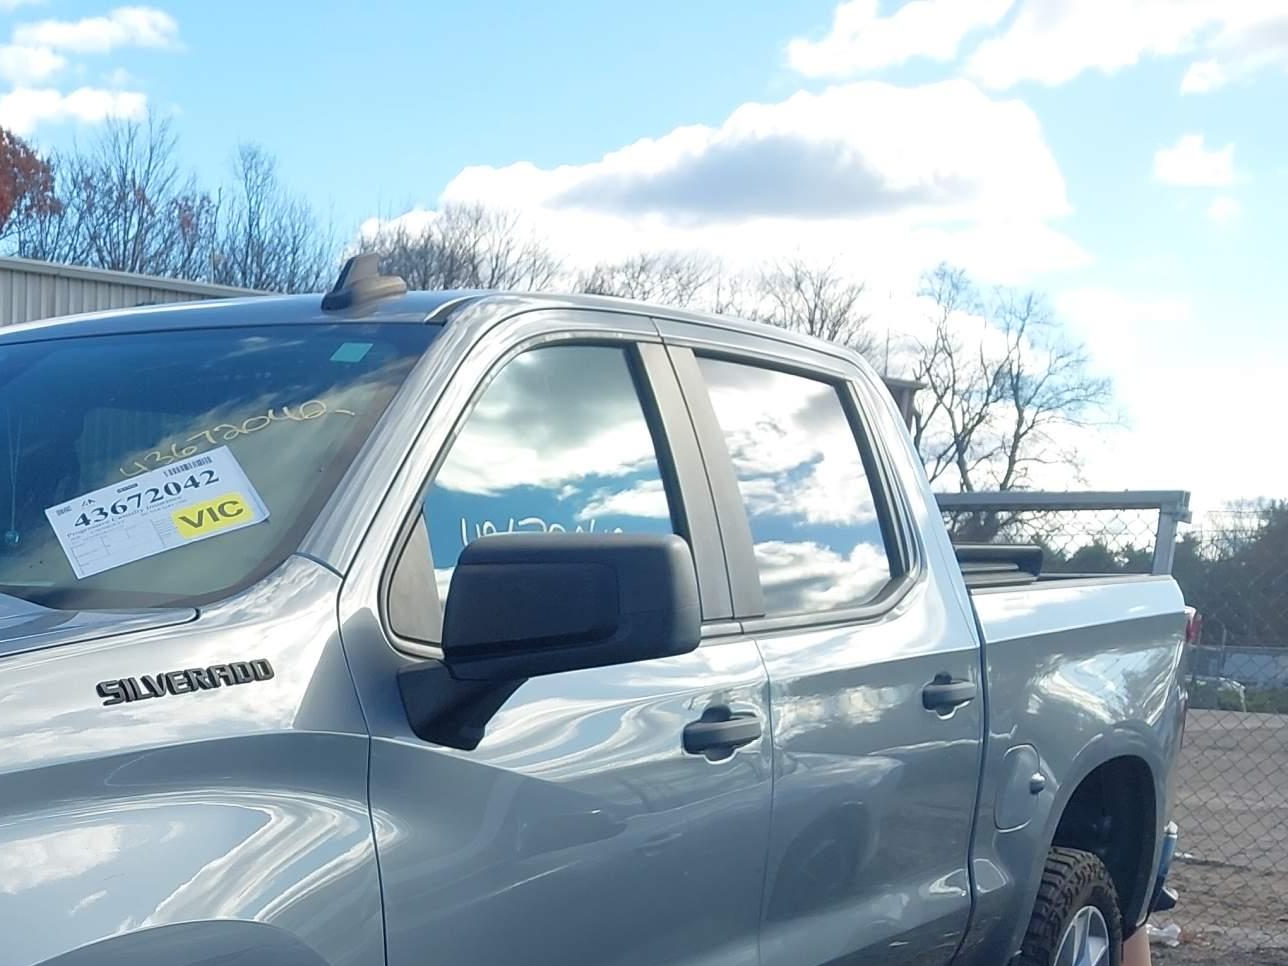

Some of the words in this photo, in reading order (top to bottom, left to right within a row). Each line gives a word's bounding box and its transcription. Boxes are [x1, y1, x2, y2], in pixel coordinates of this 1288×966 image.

[74, 469, 219, 527] 43672042
[178, 500, 244, 529] VIC
[96, 658, 275, 706] SILVERADO
